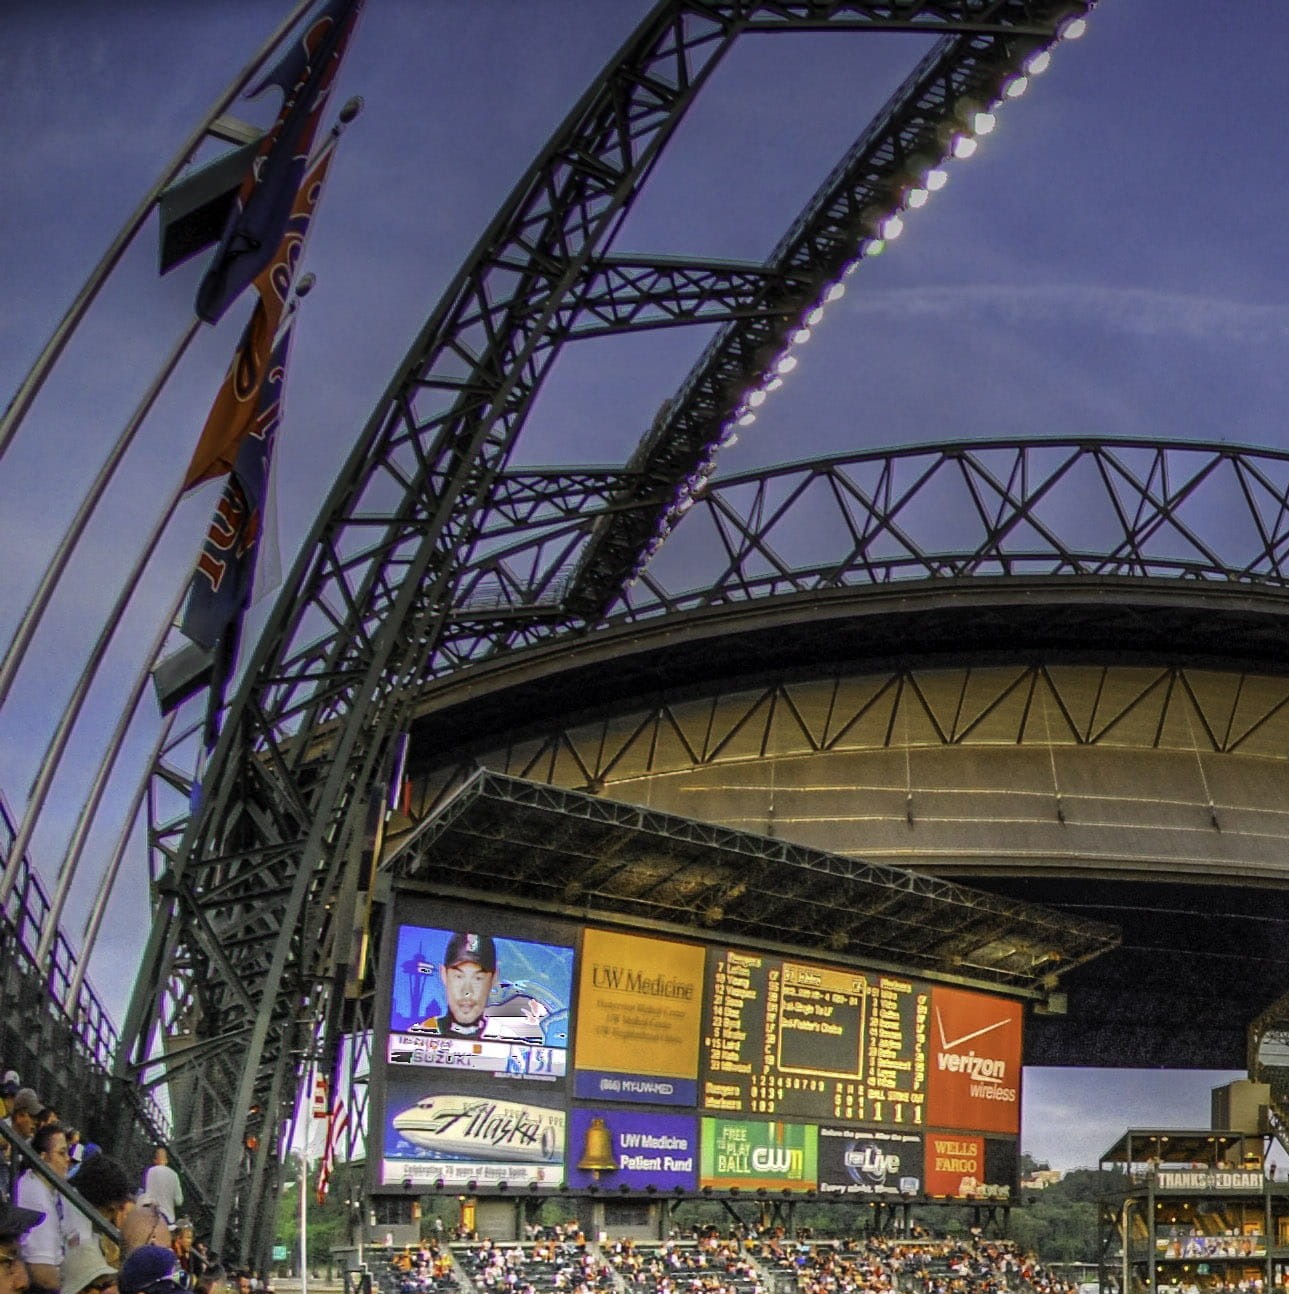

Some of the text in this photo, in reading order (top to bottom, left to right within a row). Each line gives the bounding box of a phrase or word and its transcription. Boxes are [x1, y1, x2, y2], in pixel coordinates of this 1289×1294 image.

[592, 964, 695, 1000] UW Medicine
[413, 1049, 472, 1067] SUZUKI
[937, 1050, 1006, 1084] verizon
[970, 1082, 1016, 1102] wireless
[874, 1102, 921, 1124] 1 1 1
[433, 1103, 541, 1146] Alaska
[620, 1134, 688, 1150] UW Medicine
[723, 1127, 748, 1142] FREE
[727, 1140, 750, 1157] PLAY
[934, 1140, 978, 1156] WELLS
[620, 1155, 693, 1172] Patient Fund
[717, 1155, 751, 1173] BALL
[861, 1147, 900, 1176] Live
[935, 1157, 977, 1173] FARGO
[1159, 1172, 1264, 1190] THANKS EDGAR!
